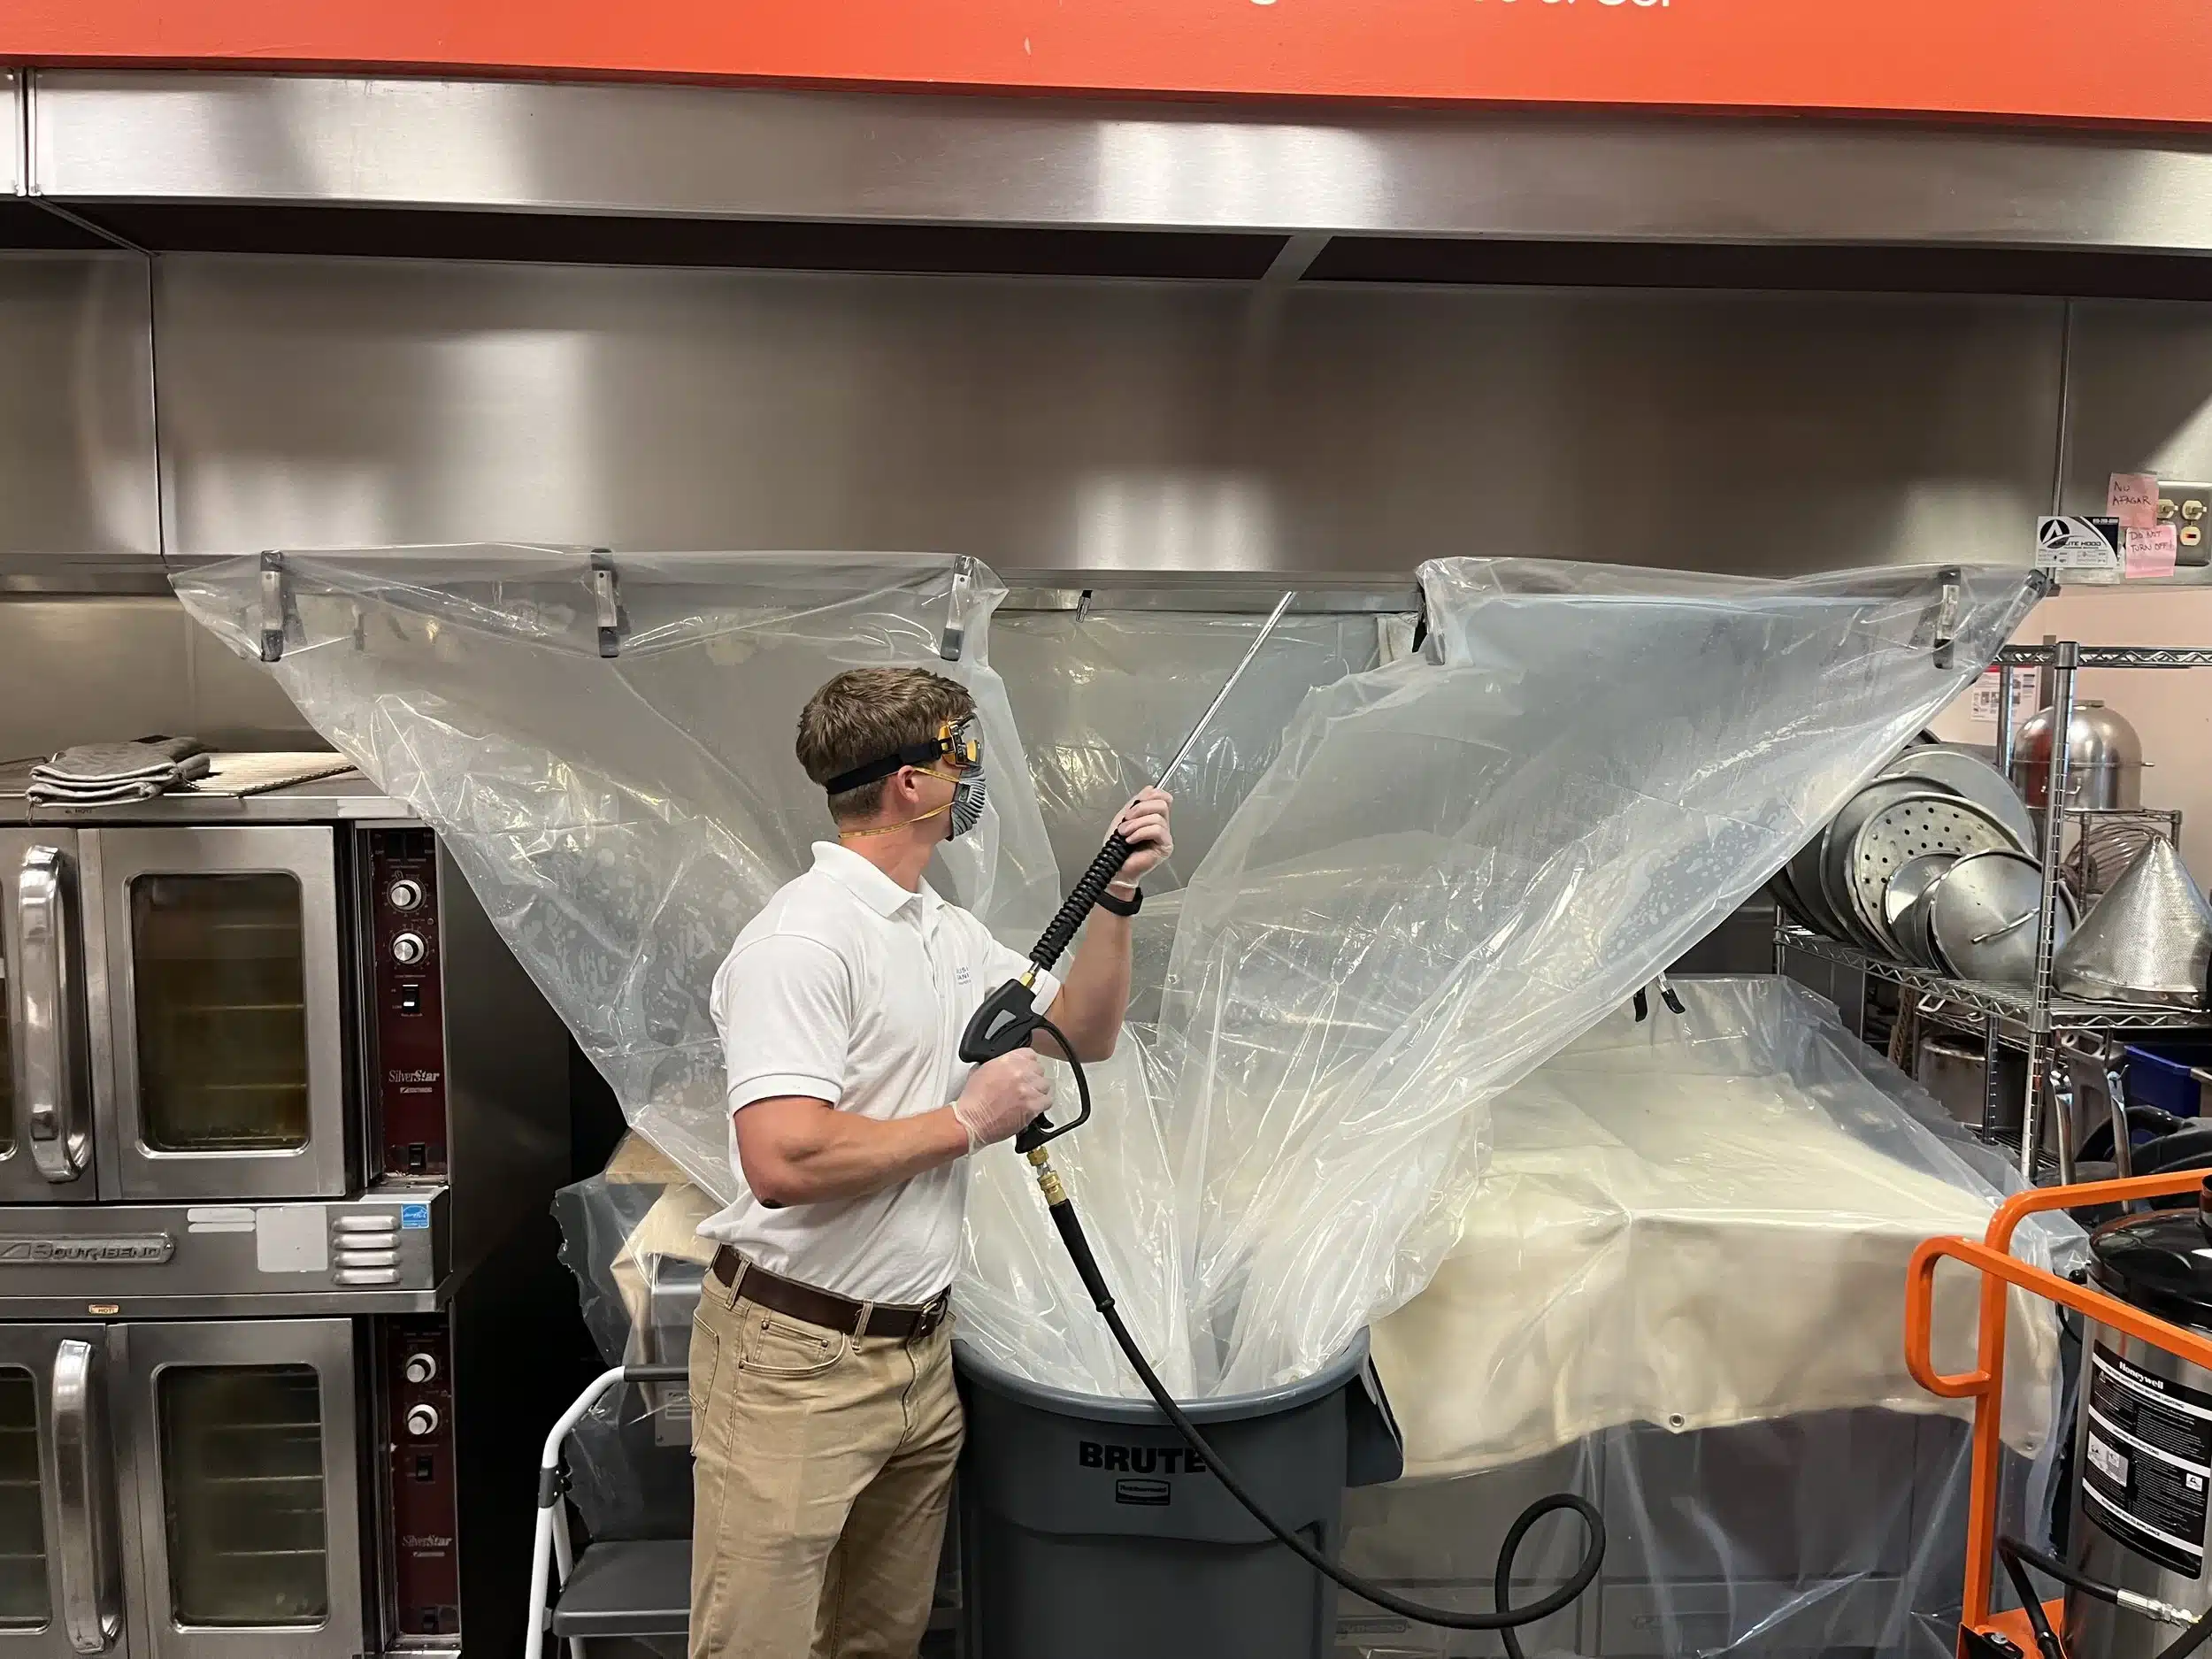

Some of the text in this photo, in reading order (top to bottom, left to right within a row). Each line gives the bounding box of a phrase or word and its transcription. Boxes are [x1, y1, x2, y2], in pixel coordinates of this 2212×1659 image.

[389, 1069, 440, 1082] SilverStar
[2118, 1361, 2164, 1390] Honeywell
[1079, 1440, 1207, 1474] BRUTE
